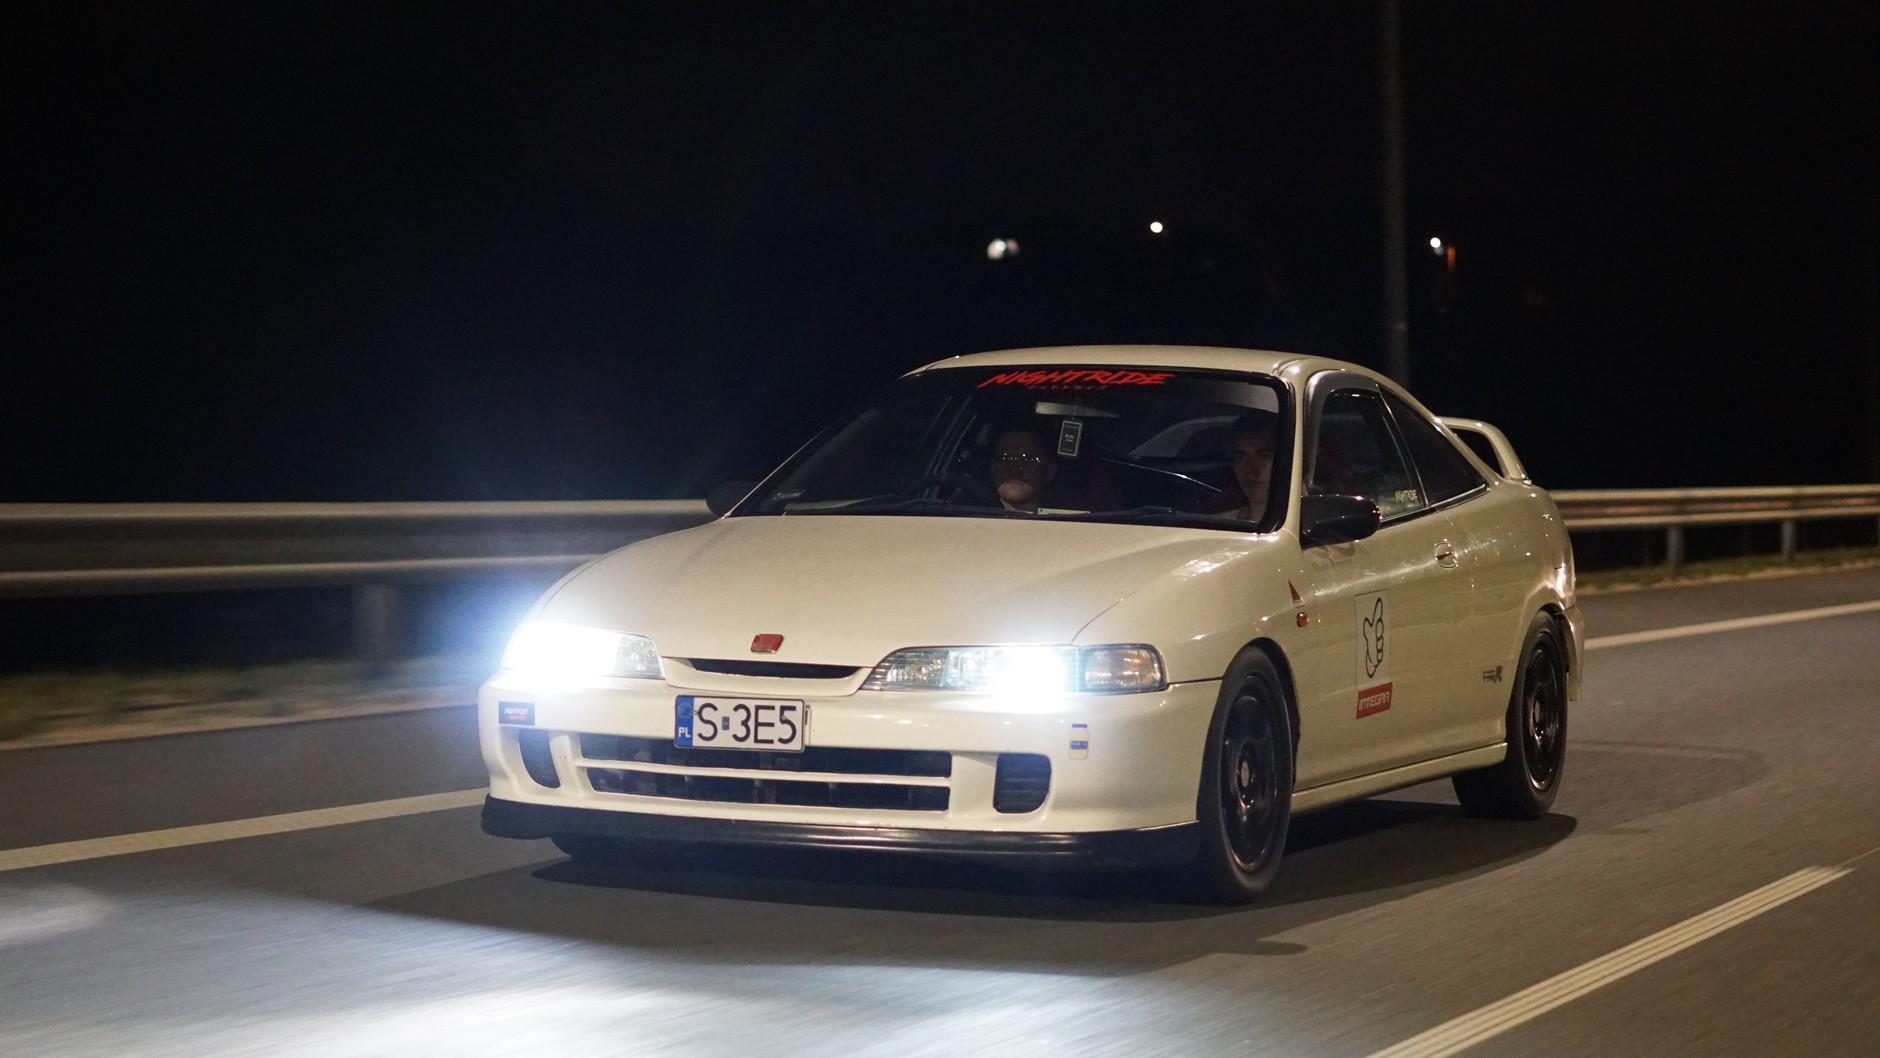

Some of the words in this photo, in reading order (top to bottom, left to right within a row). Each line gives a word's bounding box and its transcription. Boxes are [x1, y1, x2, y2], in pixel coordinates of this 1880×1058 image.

[977, 369, 1175, 388] NIGHTRIDE
[1358, 691, 1390, 711] INTEGRA
[678, 726, 691, 737] PL
[697, 702, 718, 741] S
[731, 703, 797, 745] 3E5
